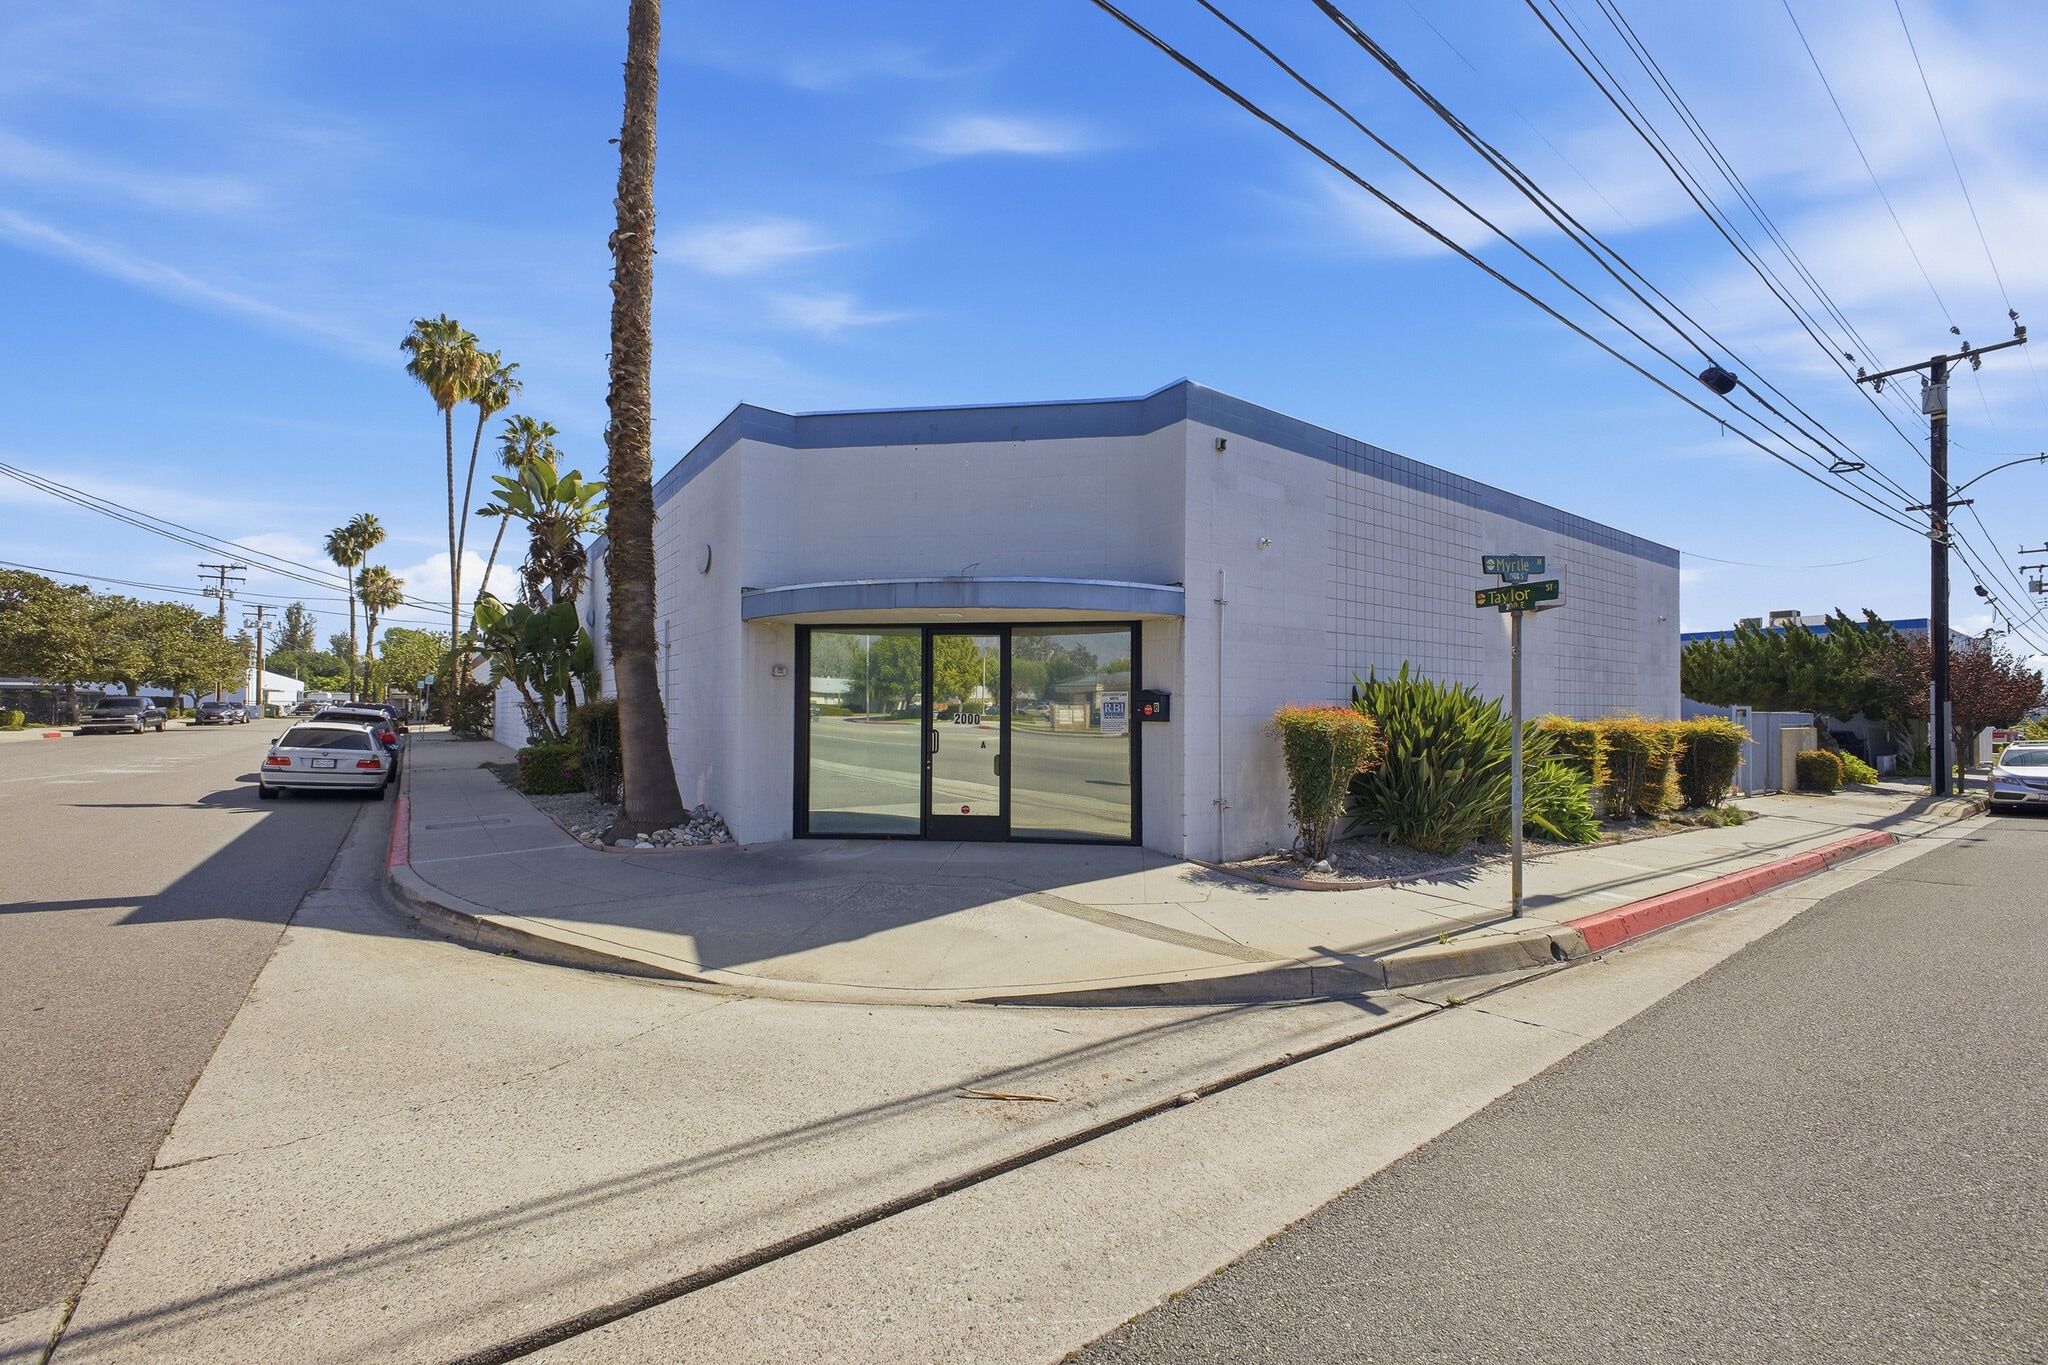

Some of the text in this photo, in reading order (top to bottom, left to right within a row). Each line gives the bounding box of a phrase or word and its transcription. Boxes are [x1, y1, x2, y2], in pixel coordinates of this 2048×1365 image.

[1496, 558, 1529, 572] Myrtle
[1488, 589, 1530, 604] Taylor
[1105, 703, 1124, 713] RBI
[954, 713, 980, 725] 2000
[980, 741, 986, 749] A
